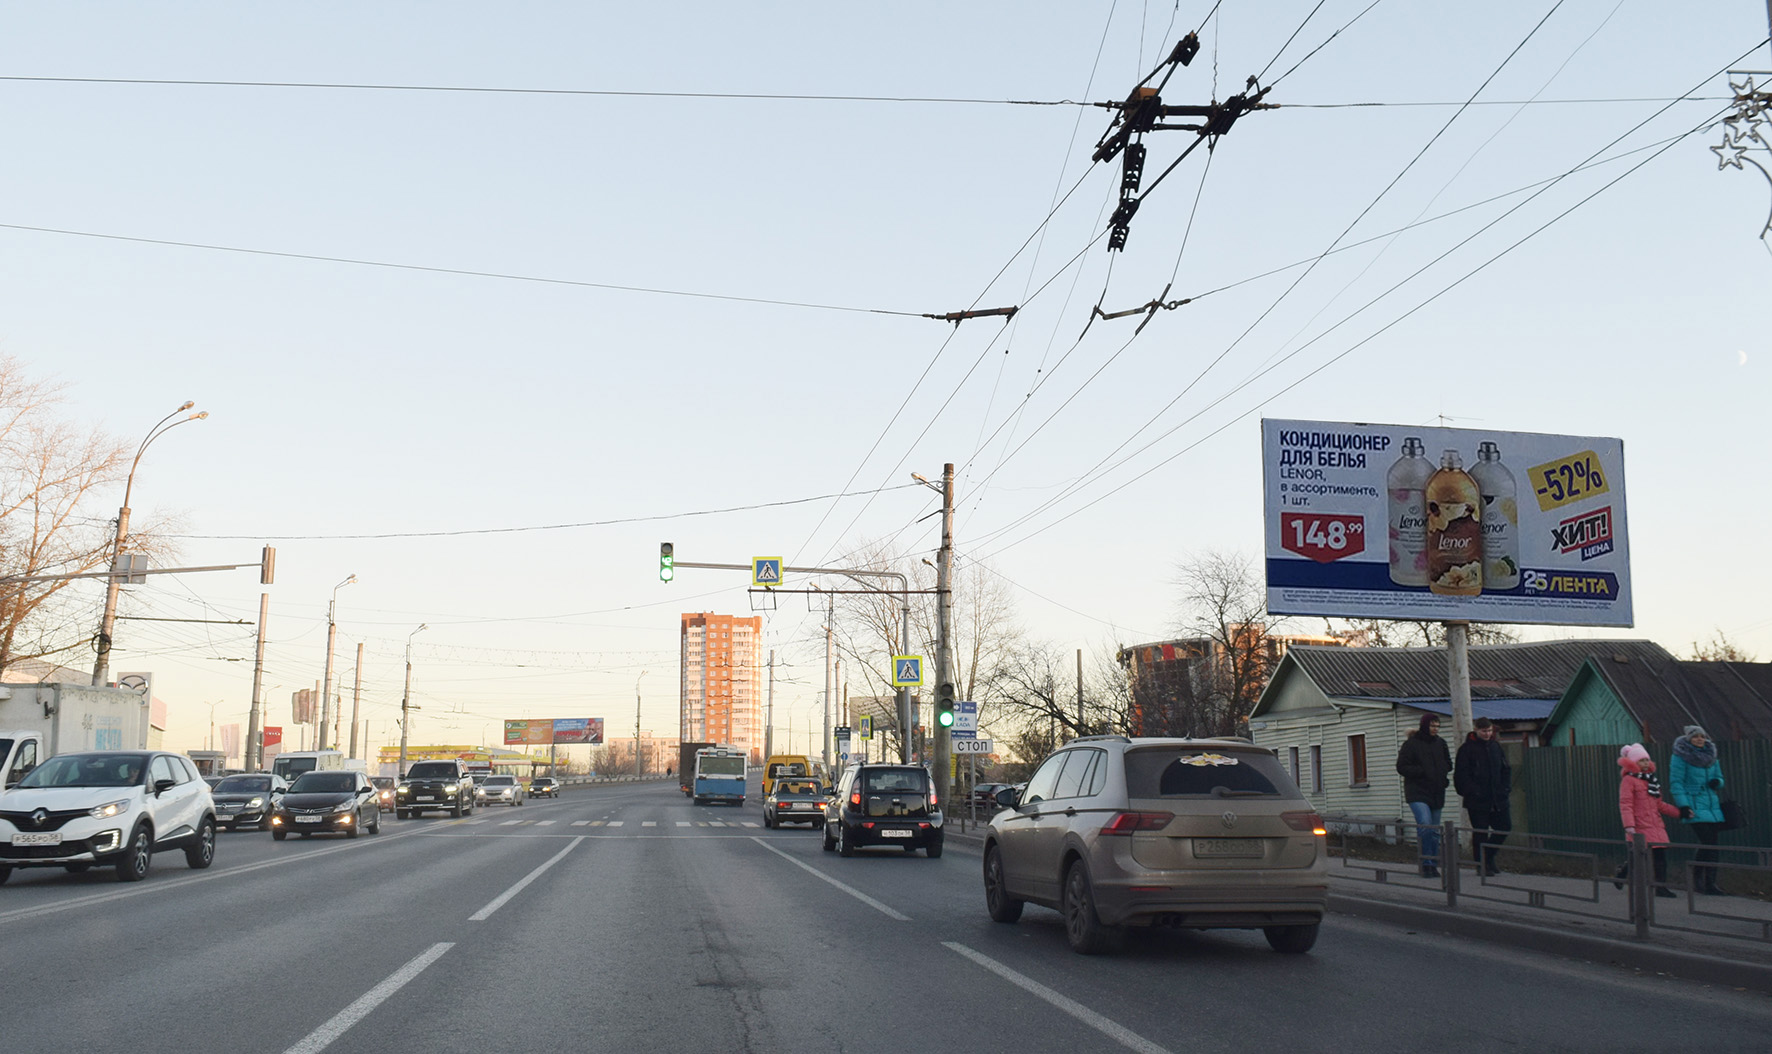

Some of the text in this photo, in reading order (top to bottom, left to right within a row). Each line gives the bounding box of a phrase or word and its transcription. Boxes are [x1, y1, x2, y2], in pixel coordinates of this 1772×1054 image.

[1280, 430, 1391, 451] КОНДИЦИОНЕР
[1280, 450, 1367, 469] ДЛЯ БЕЛЬЯ
[1280, 468, 1327, 482] LENOR,
[1537, 457, 1604, 502] -52%
[1280, 483, 1380, 498] в ассортименте,
[1282, 494, 1311, 506] 1 шт.
[1551, 513, 1608, 551] ХИТ!
[1438, 533, 1473, 549] Lenor
[1583, 542, 1610, 558] ЦЕНА
[1549, 576, 1610, 594] ЛЕНТА
[957, 741, 988, 752] СТОП
